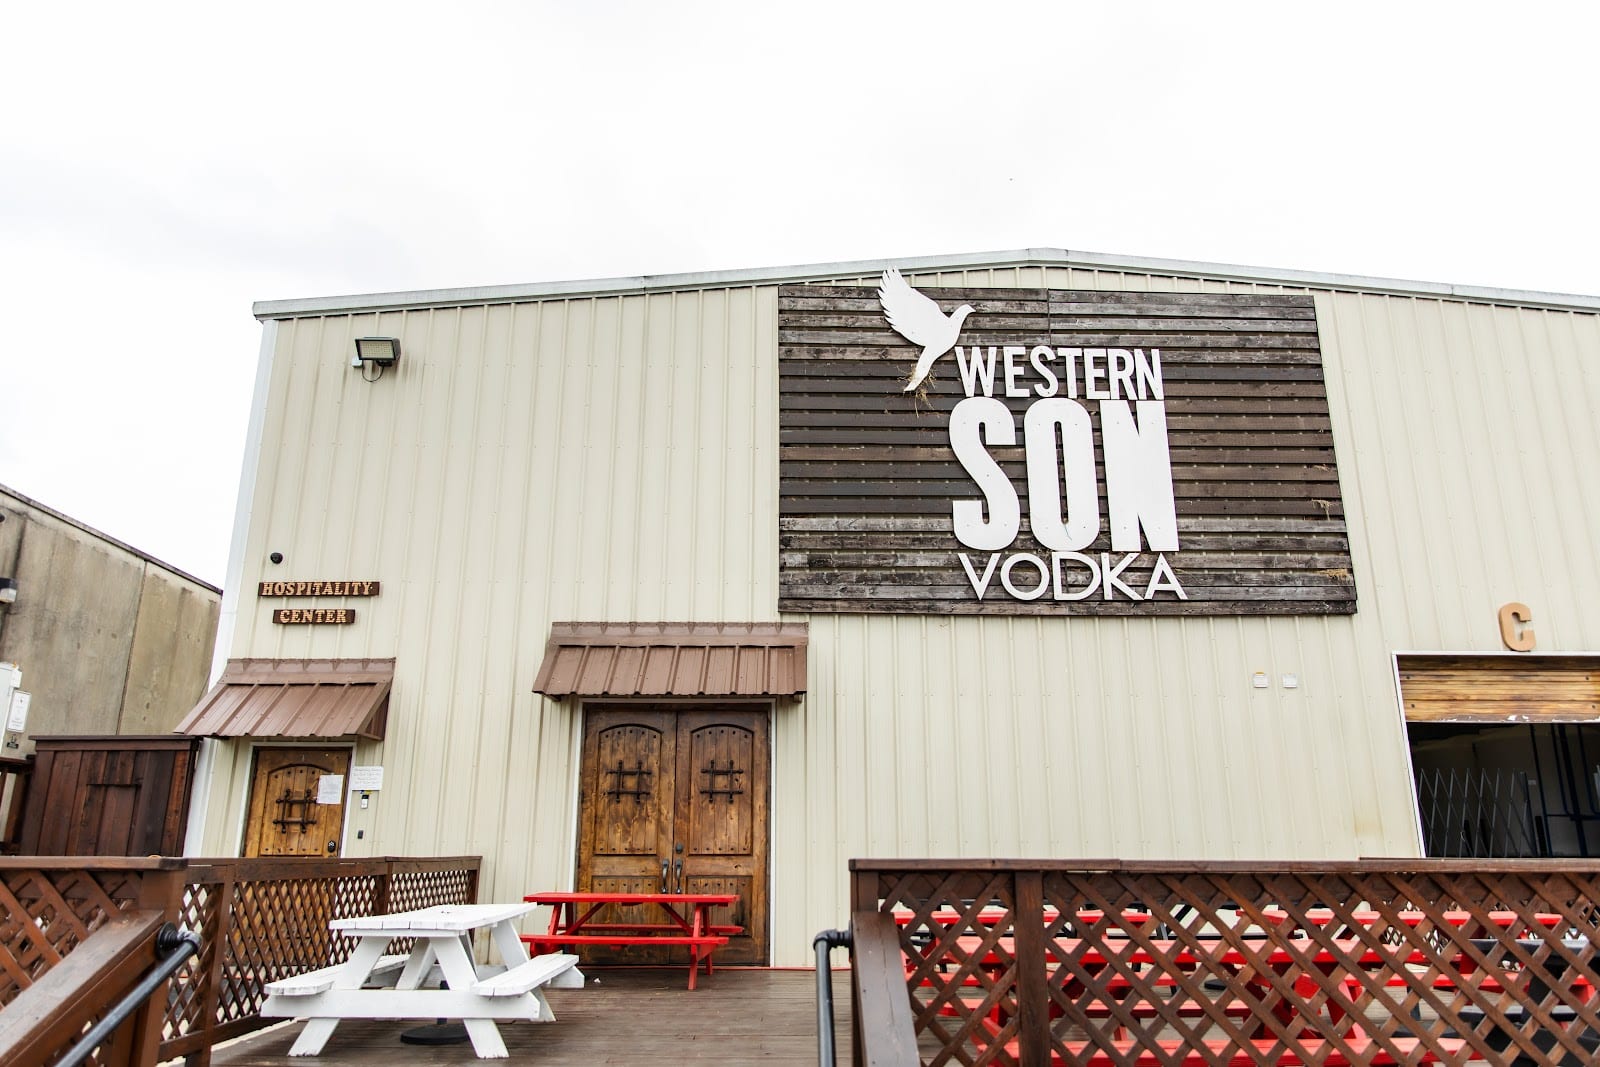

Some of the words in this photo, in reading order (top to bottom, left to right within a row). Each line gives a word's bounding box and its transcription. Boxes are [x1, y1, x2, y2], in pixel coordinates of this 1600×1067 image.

[955, 346, 1164, 400] WESTERN
[950, 398, 1179, 551] SON
[262, 582, 372, 595] HOSPITALITY
[958, 551, 1188, 600] VODKA
[280, 609, 347, 623] CENTER
[1498, 602, 1536, 652] C
